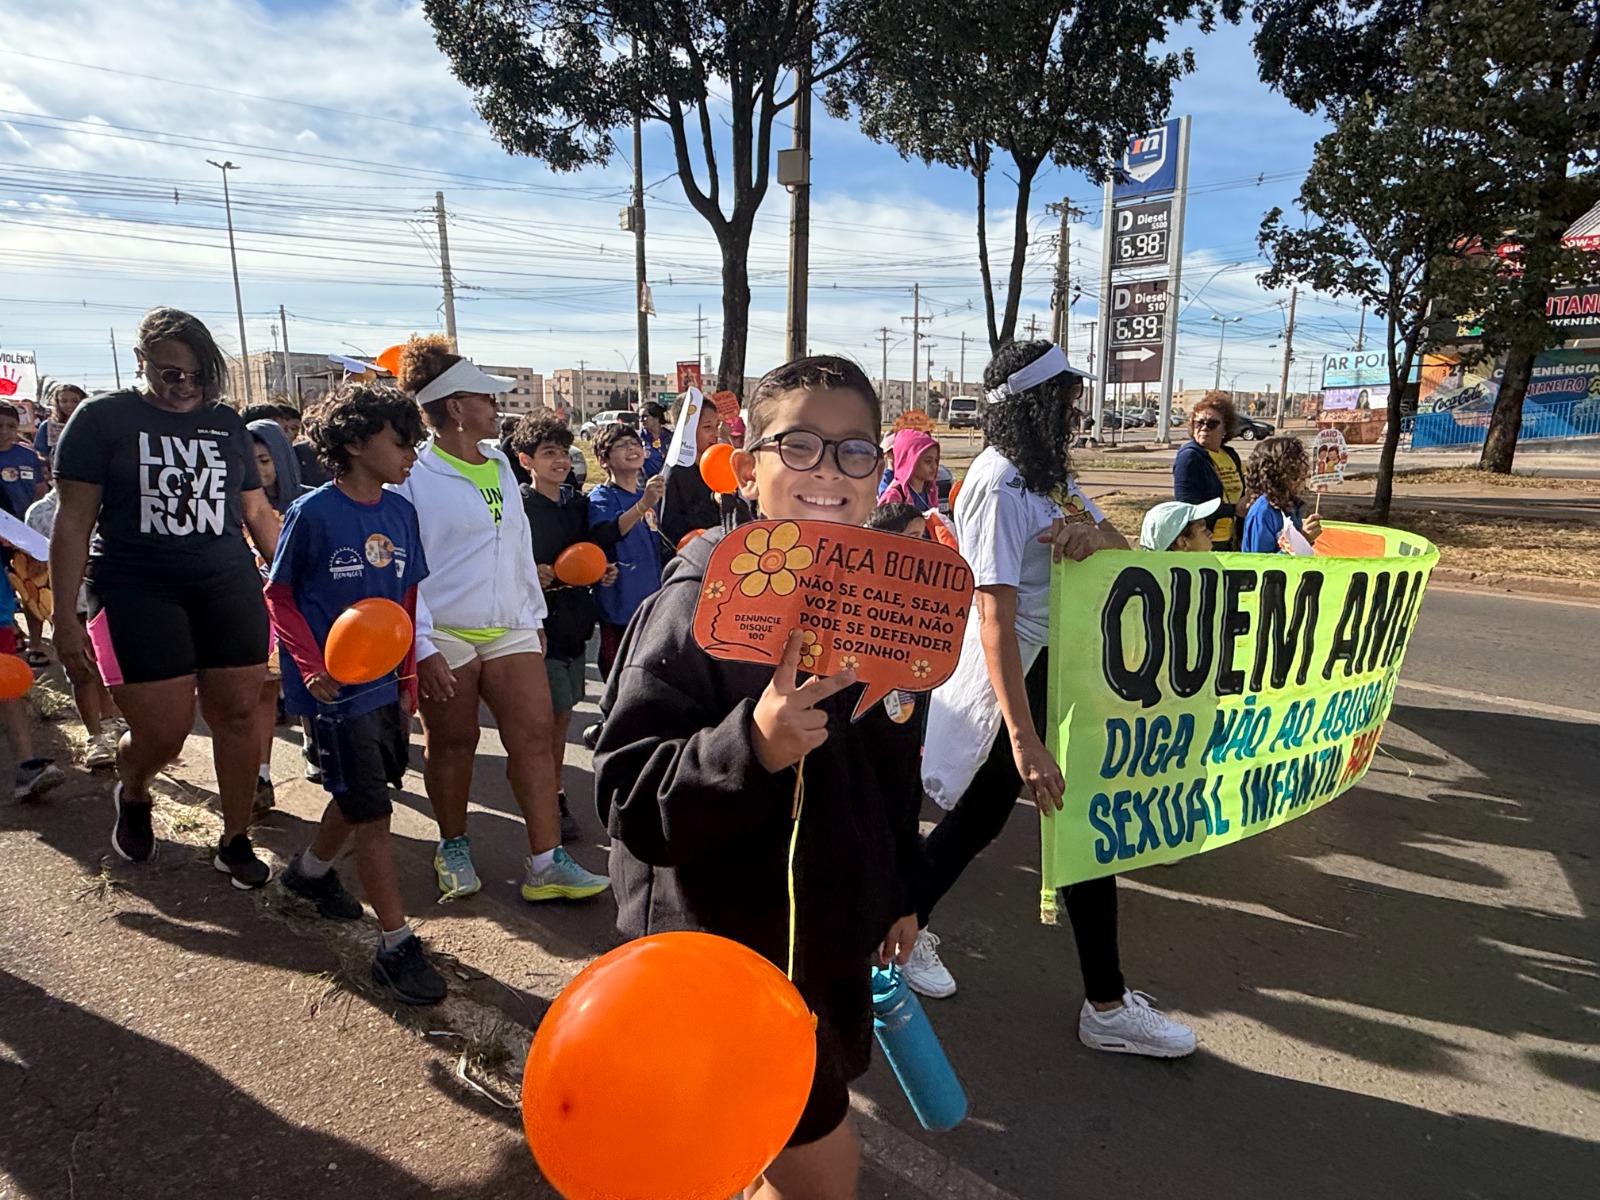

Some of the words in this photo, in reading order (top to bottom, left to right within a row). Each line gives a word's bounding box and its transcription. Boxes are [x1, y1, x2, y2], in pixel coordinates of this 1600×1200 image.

[1117, 210, 1133, 232] D
[1137, 211, 1168, 225] Diesel
[1151, 221, 1168, 230] S500
[1120, 233, 1160, 258] 6,98
[1114, 288, 1131, 310] D
[1135, 291, 1166, 304] Diesel
[1147, 302, 1165, 312] S10
[1116, 315, 1158, 339] 6,99
[1326, 356, 1349, 370] AR
[139, 431, 227, 468] LIVE
[140, 465, 227, 499] LOVE
[140, 496, 225, 536] RUN
[815, 537, 875, 575] FAÇA
[884, 551, 968, 593] BONITO
[799, 575, 834, 593] NÃO
[838, 582, 858, 598] SE
[863, 587, 906, 609] CALE,
[910, 597, 950, 616] SEJA
[955, 606, 967, 620] A
[734, 614, 782, 626] DENUNCIE
[803, 594, 837, 613] VOZ
[841, 602, 861, 616] DE
[866, 607, 914, 628] QUEM
[918, 614, 955, 635] NÃO
[739, 623, 774, 634] DISQUE
[748, 632, 765, 642] 100
[799, 612, 841, 633] PODE
[846, 621, 865, 637] SE
[870, 627, 952, 654] DEFENDER
[1100, 566, 1324, 709] QUEM
[832, 637, 911, 664] SOZINHO!
[1100, 713, 1195, 779] DIGA
[1201, 695, 1272, 766] NÃO
[1268, 700, 1315, 754] AO
[1312, 677, 1384, 745] ABUSO
[1088, 775, 1230, 865] SEXUAL
[1240, 743, 1344, 828] INFANTIL
